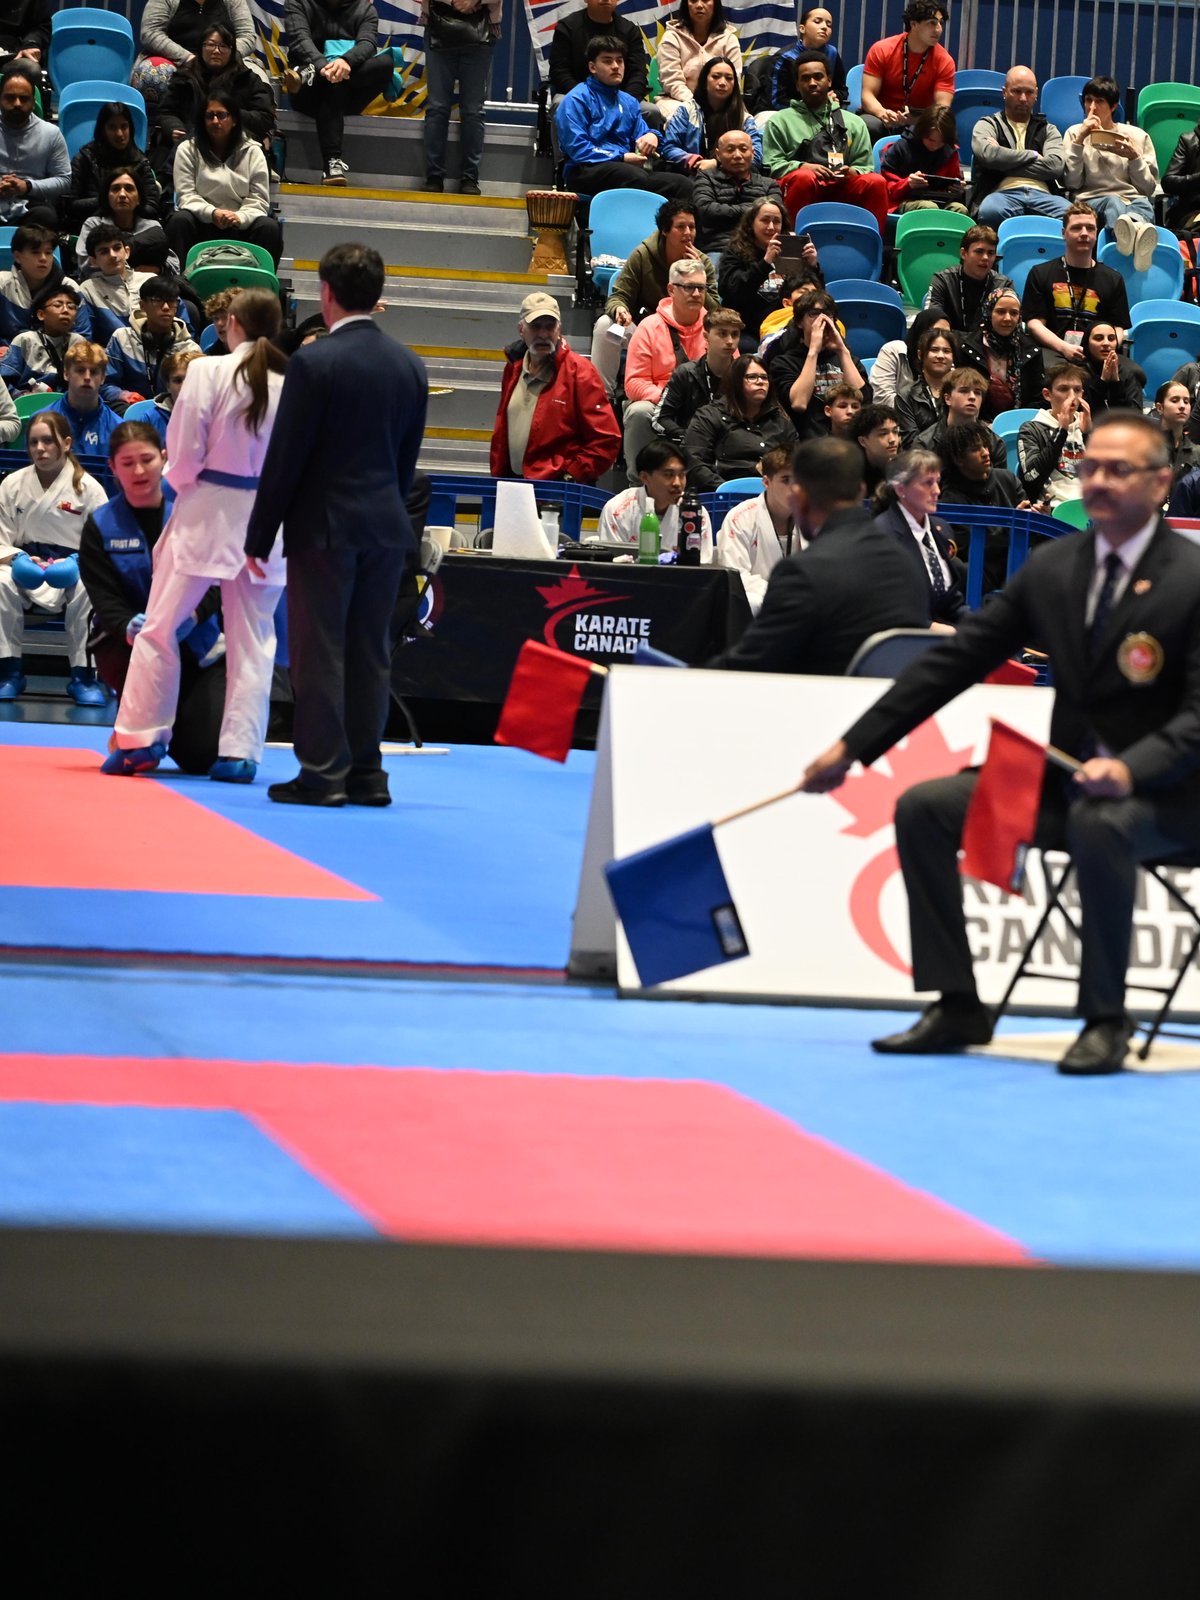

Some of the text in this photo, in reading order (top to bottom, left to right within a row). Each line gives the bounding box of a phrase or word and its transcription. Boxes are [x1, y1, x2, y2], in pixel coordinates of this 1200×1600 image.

[110, 538, 140, 549] FIRST AID
[575, 614, 651, 637] KARATE
